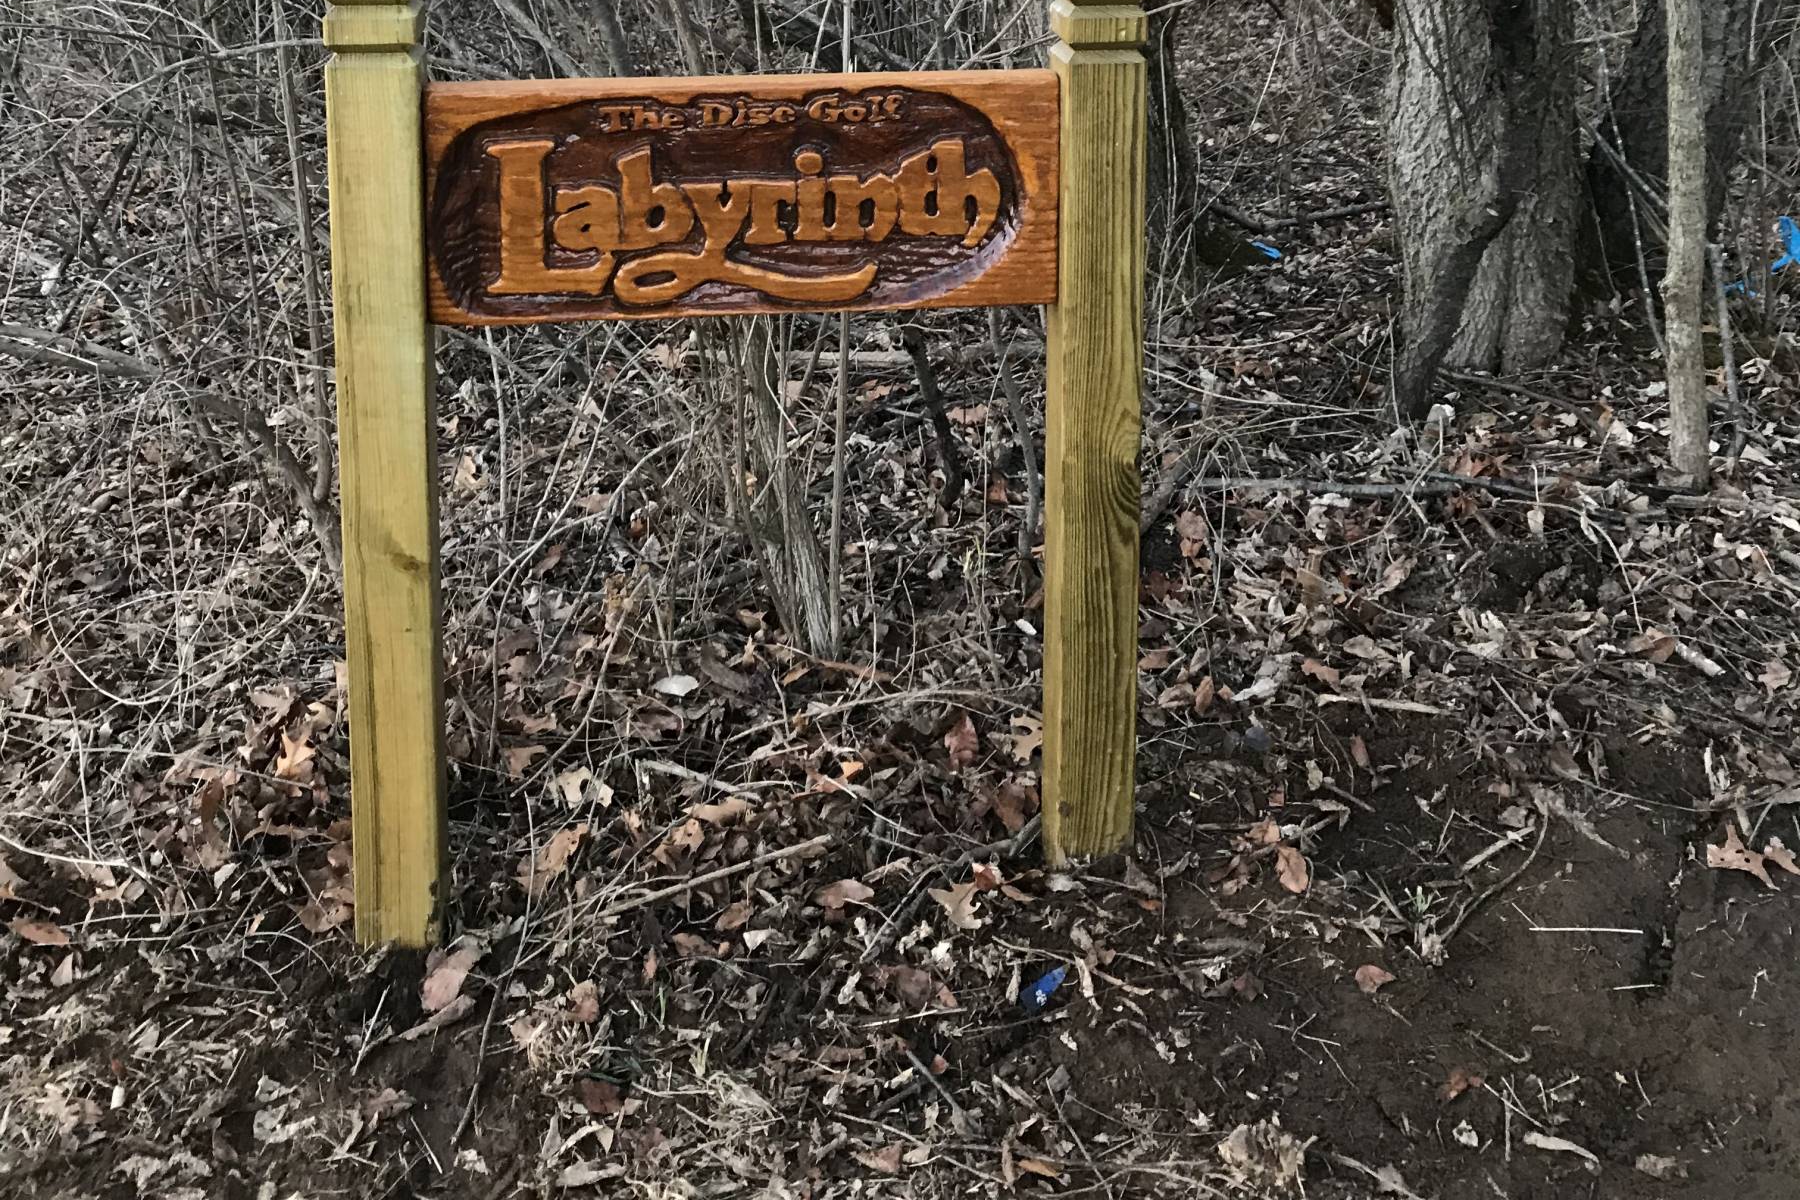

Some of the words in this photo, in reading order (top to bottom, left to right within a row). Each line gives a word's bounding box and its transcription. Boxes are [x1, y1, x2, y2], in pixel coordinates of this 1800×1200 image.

[599, 104, 686, 132] The
[700, 100, 796, 128] Disc
[808, 93, 904, 123] Golf
[486, 139, 1000, 301] Labyrinth
